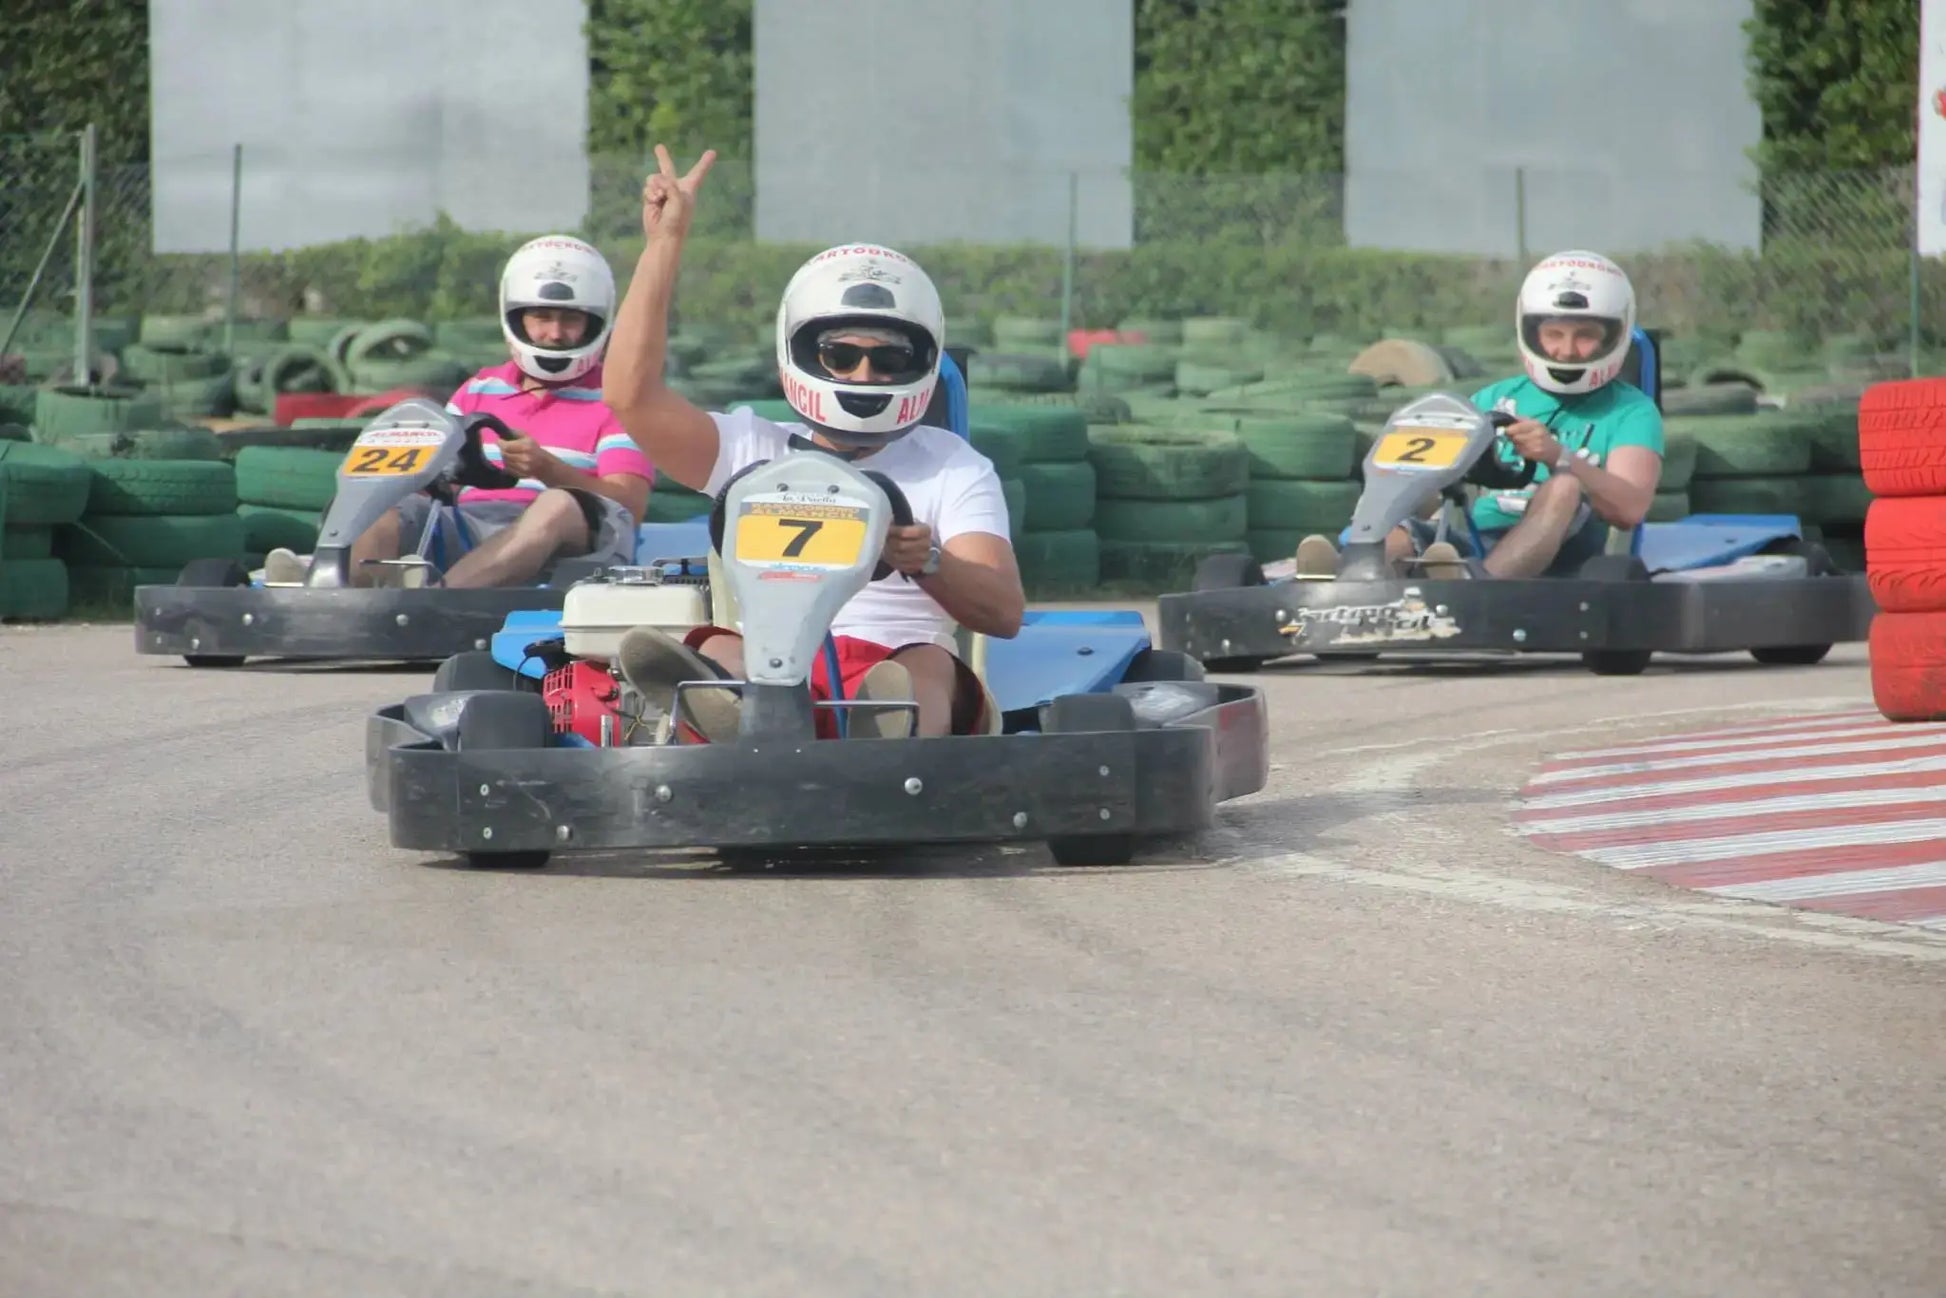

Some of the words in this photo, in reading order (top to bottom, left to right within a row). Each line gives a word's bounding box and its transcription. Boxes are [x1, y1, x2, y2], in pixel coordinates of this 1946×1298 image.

[810, 246, 914, 264] ARTODRO
[896, 388, 932, 425] ALM
[352, 449, 421, 472] 24
[1396, 437, 1436, 462] 2
[779, 519, 823, 557] 7
